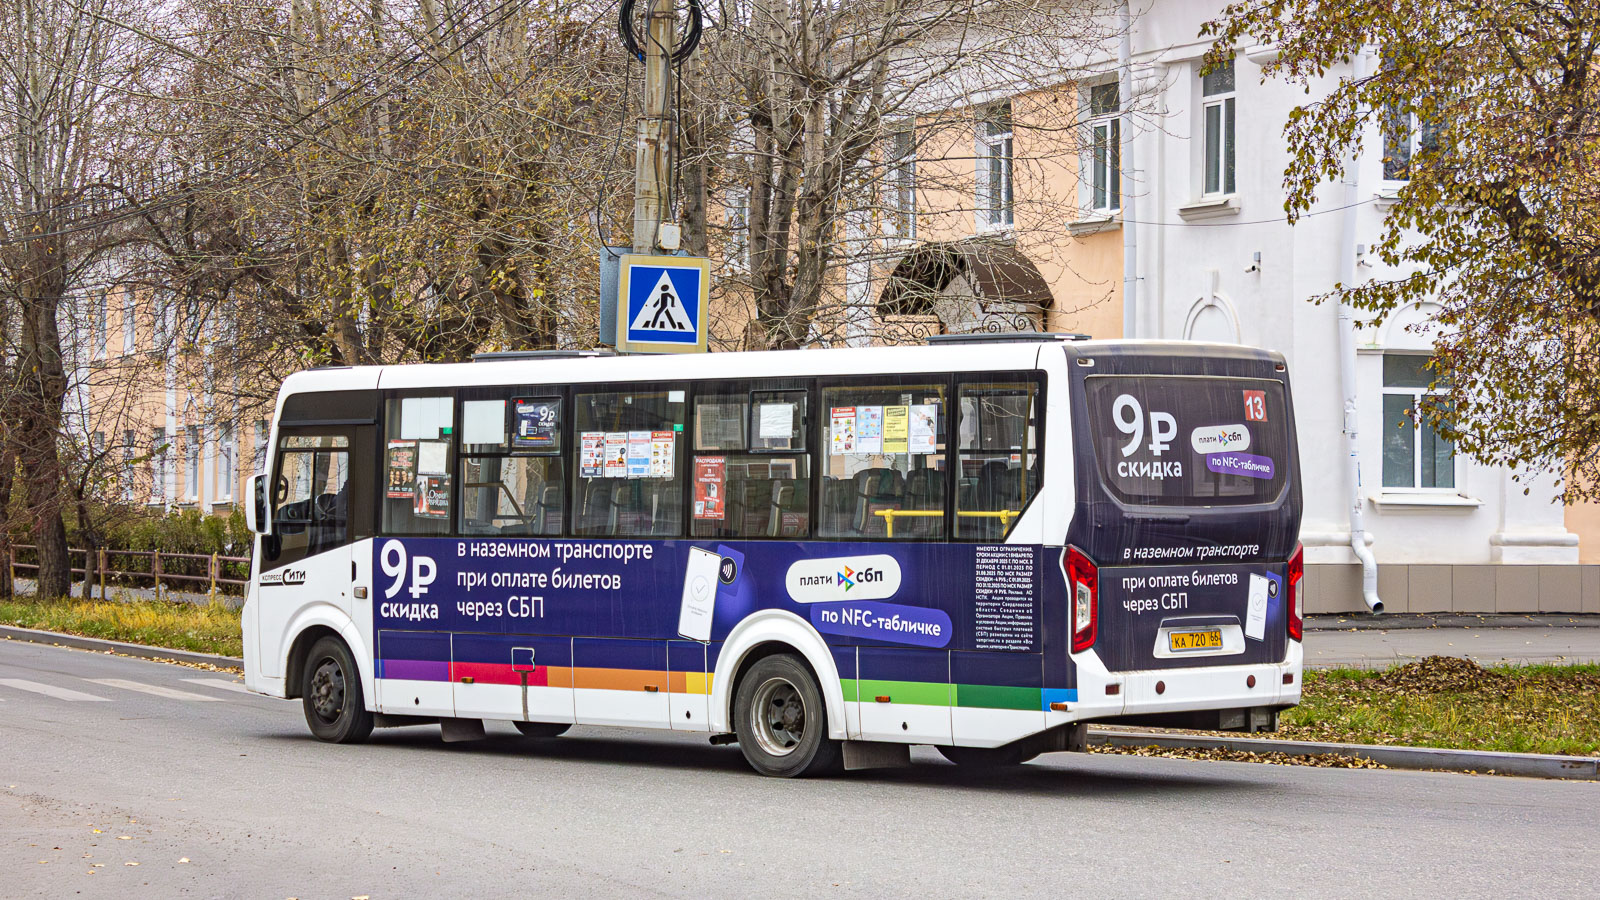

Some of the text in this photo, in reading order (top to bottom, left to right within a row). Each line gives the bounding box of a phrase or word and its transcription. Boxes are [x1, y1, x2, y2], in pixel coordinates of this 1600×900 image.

[1246, 396, 1264, 420] 13
[1199, 432, 1242, 444] плати сбп
[1118, 461, 1182, 480] скидка
[1212, 457, 1270, 473] по NFC-табличке
[457, 542, 653, 564] в наземном транспорте
[1124, 544, 1259, 560] в наземном транспорте
[457, 568, 621, 591] при оплате билетов
[800, 568, 883, 586] плати сбп
[1122, 570, 1238, 592] при оплате билетов
[380, 602, 438, 622] скидка
[457, 596, 544, 621] через СБП
[1123, 592, 1188, 615] через СБП
[821, 608, 941, 636] по NFC-табличке
[1175, 631, 1218, 648] КА 720 66
